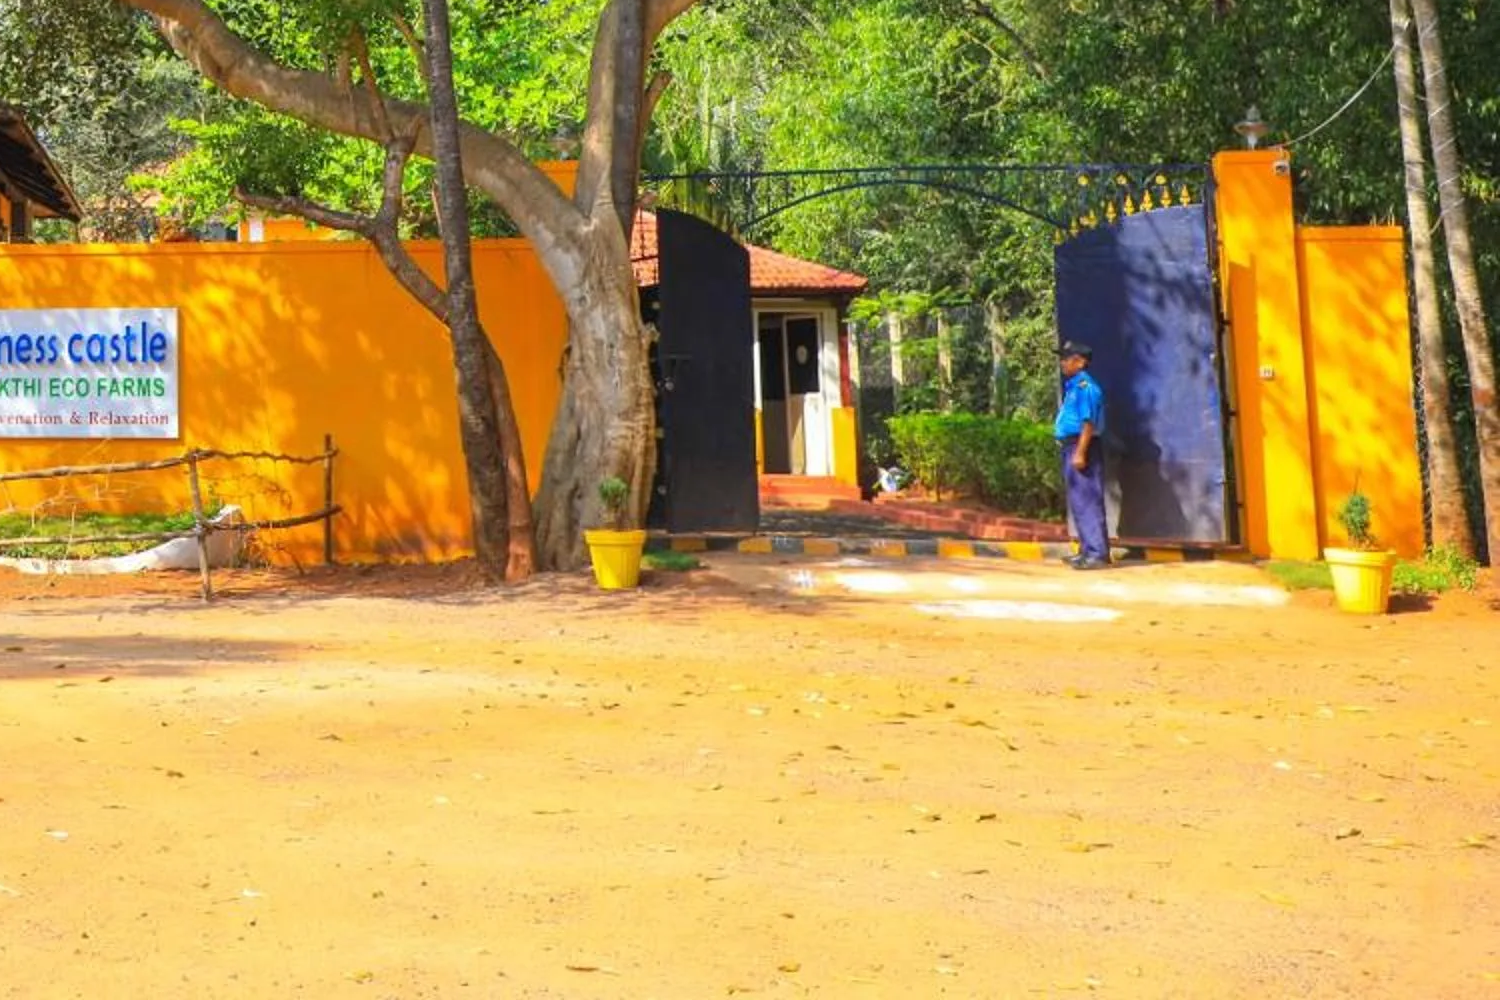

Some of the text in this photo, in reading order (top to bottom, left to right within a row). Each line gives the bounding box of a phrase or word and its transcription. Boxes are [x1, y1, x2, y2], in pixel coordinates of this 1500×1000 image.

[67, 321, 167, 363] castle
[49, 378, 90, 397] ECO
[97, 378, 165, 397] FARMS
[69, 411, 82, 425] &
[88, 410, 169, 425] Relaxation
